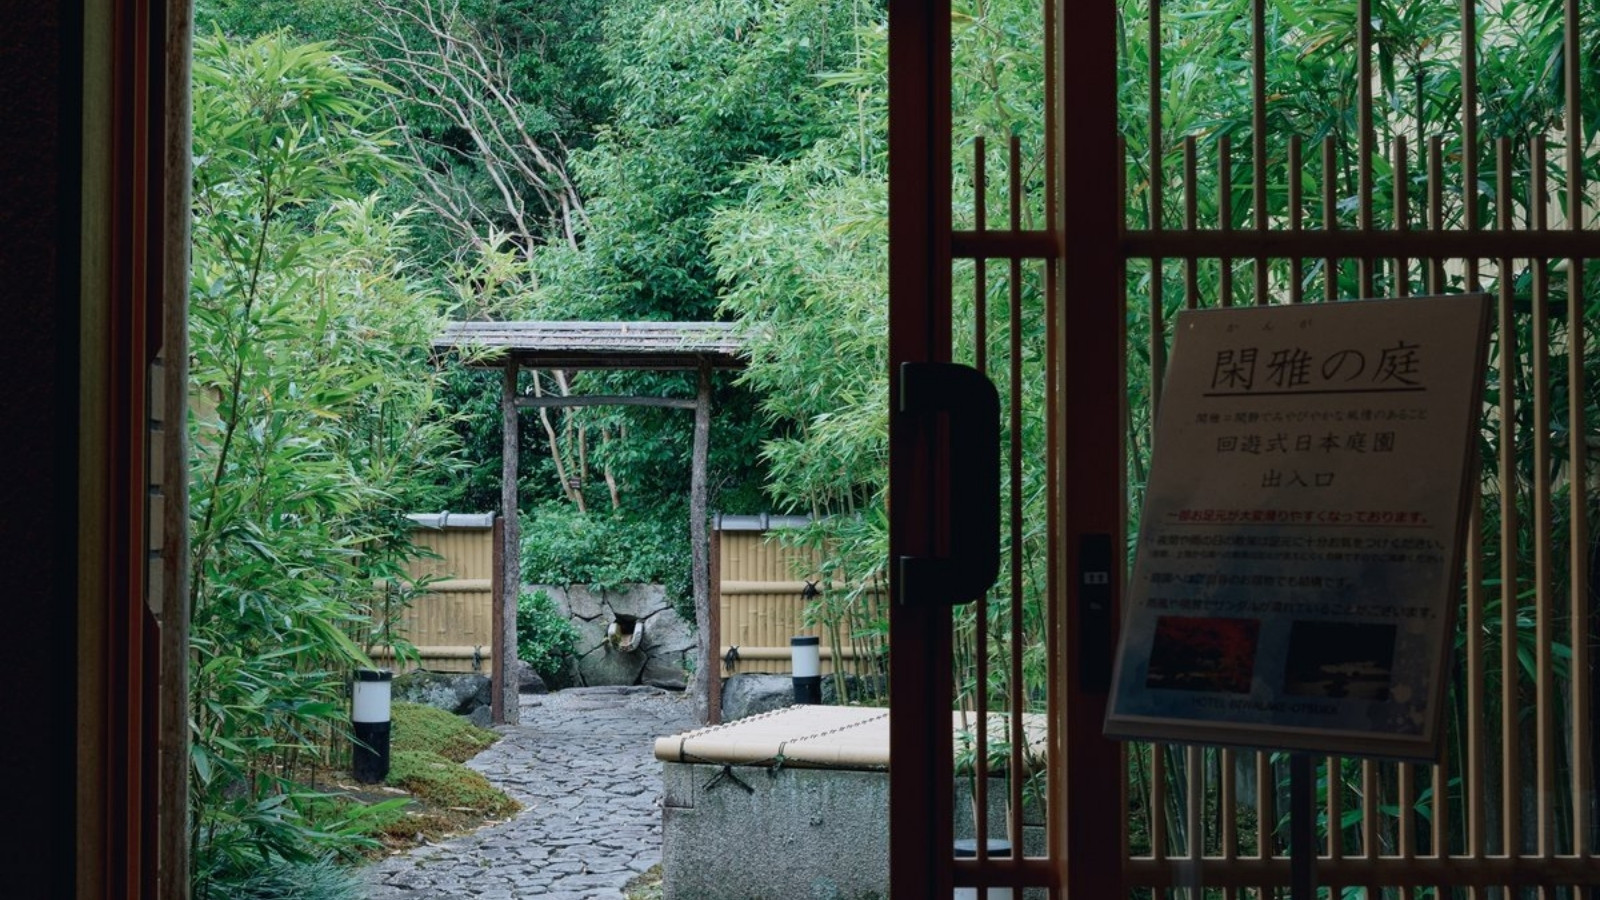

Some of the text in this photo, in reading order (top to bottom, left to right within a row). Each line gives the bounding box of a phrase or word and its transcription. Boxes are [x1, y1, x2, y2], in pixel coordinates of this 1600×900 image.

[1211, 340, 1423, 391] 閑雅の庭
[1215, 430, 1396, 455] 回遊式日本庭園
[1260, 469, 1336, 489] 出入口
[1192, 695, 1225, 709] HOTEL
